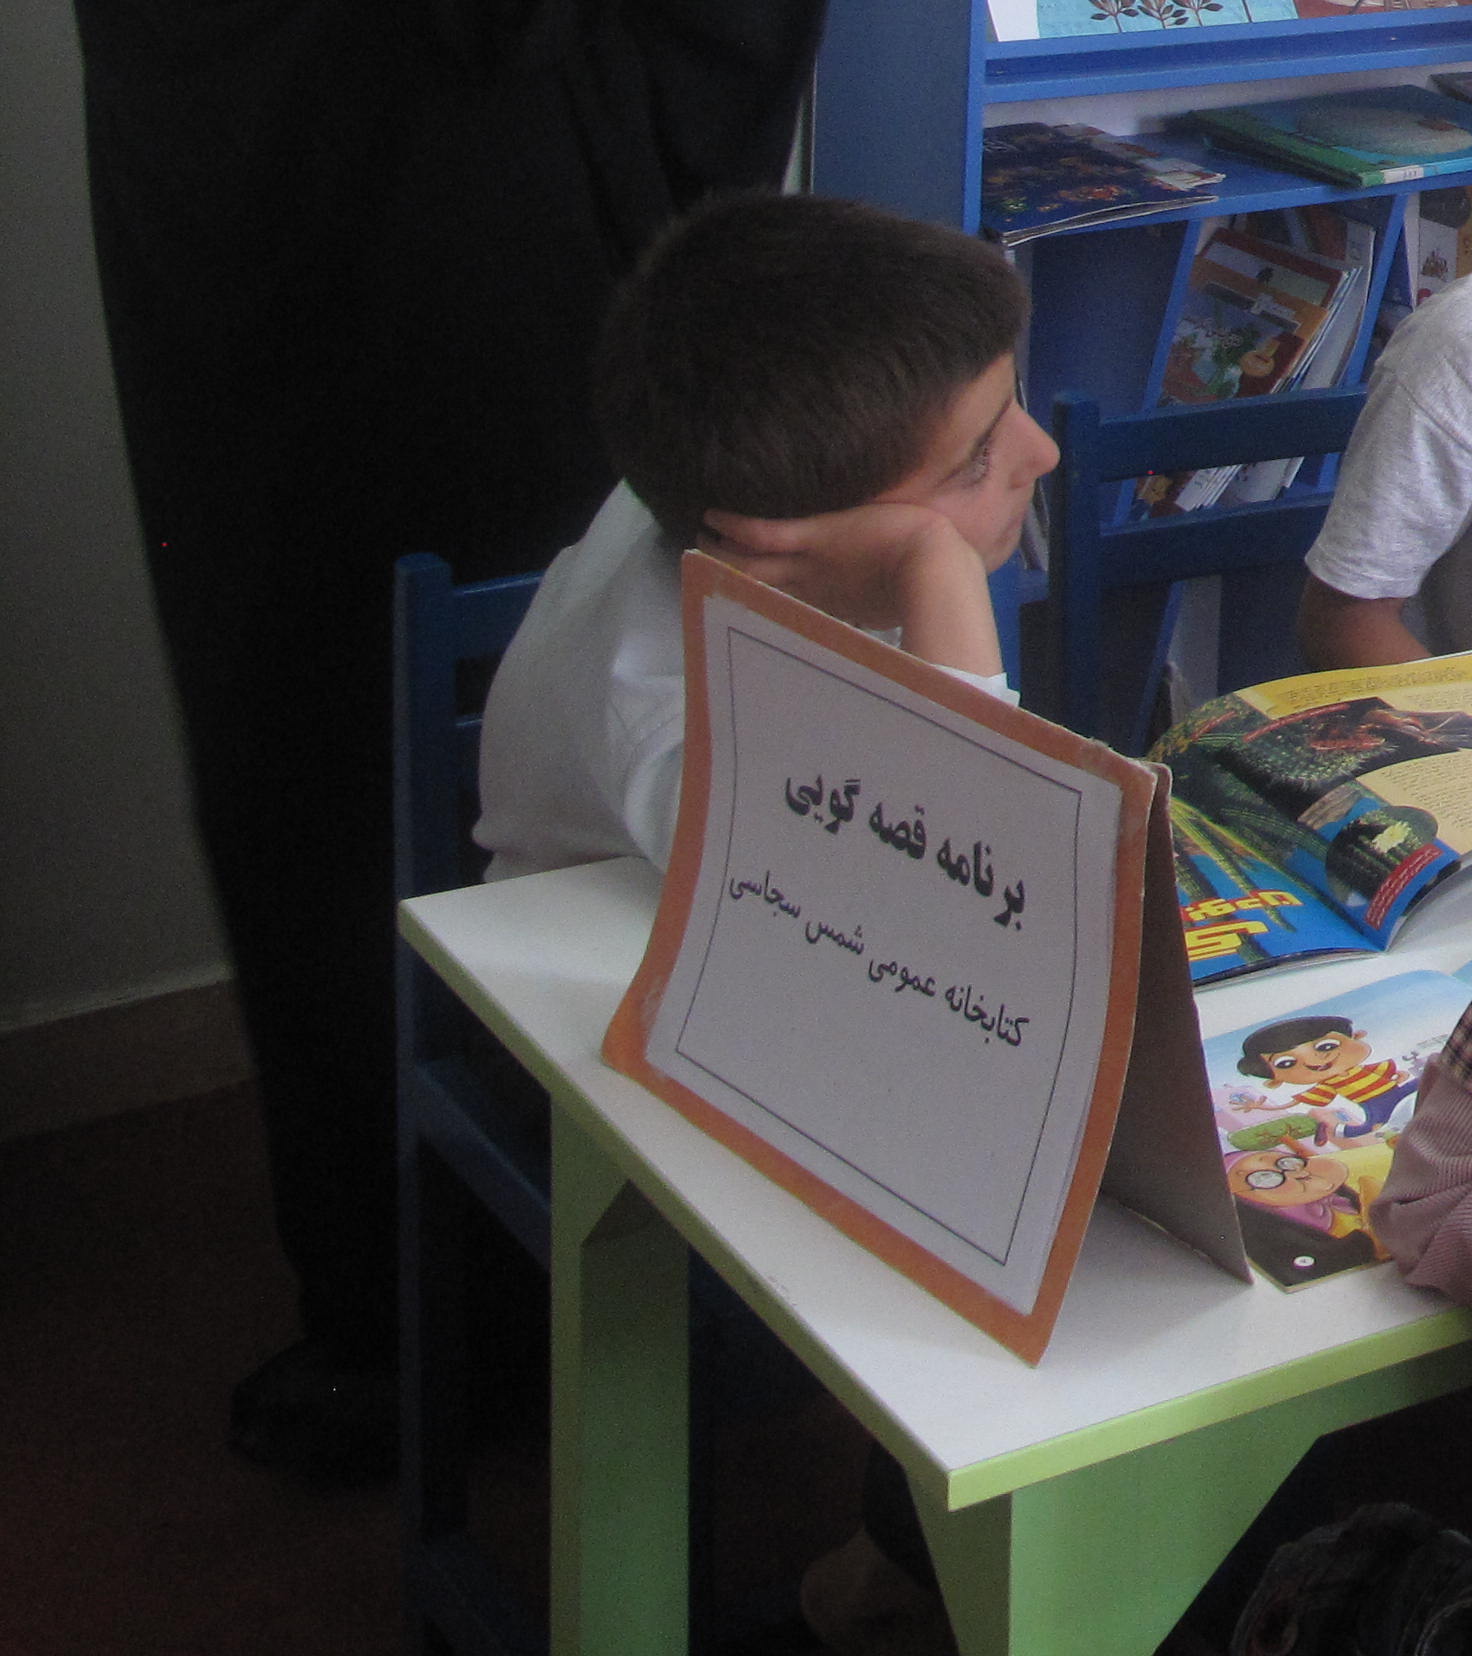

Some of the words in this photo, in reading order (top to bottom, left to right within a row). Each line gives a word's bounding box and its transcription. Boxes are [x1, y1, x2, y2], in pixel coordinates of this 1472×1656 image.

[785, 773, 861, 838] گویی
[869, 803, 929, 861] قصه
[728, 870, 801, 921] سجاسی
[938, 838, 1027, 932] برنامه
[804, 915, 866, 957] شمس
[867, 953, 936, 1000] عمومی
[945, 983, 1031, 1047] کتابخانه
